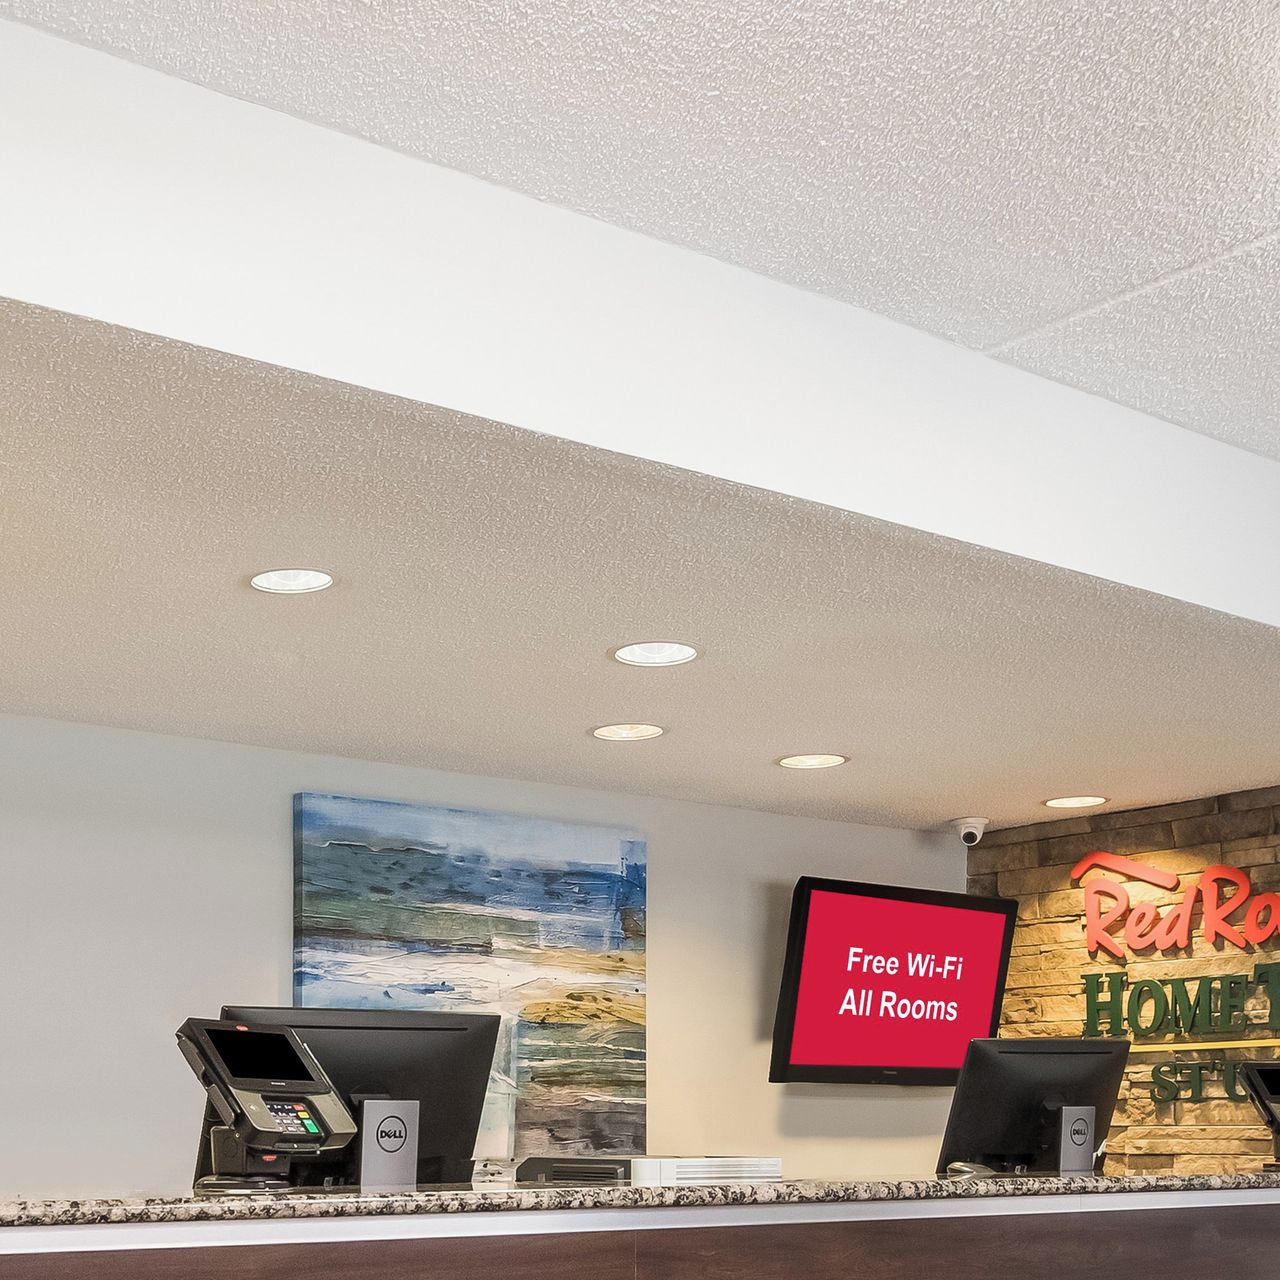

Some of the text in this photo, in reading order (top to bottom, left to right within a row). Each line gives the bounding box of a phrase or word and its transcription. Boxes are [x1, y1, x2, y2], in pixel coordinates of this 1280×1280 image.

[847, 946, 963, 980] Free Wi-Fi
[838, 988, 958, 1021] All Rooms
[379, 1129, 404, 1139] DELL
